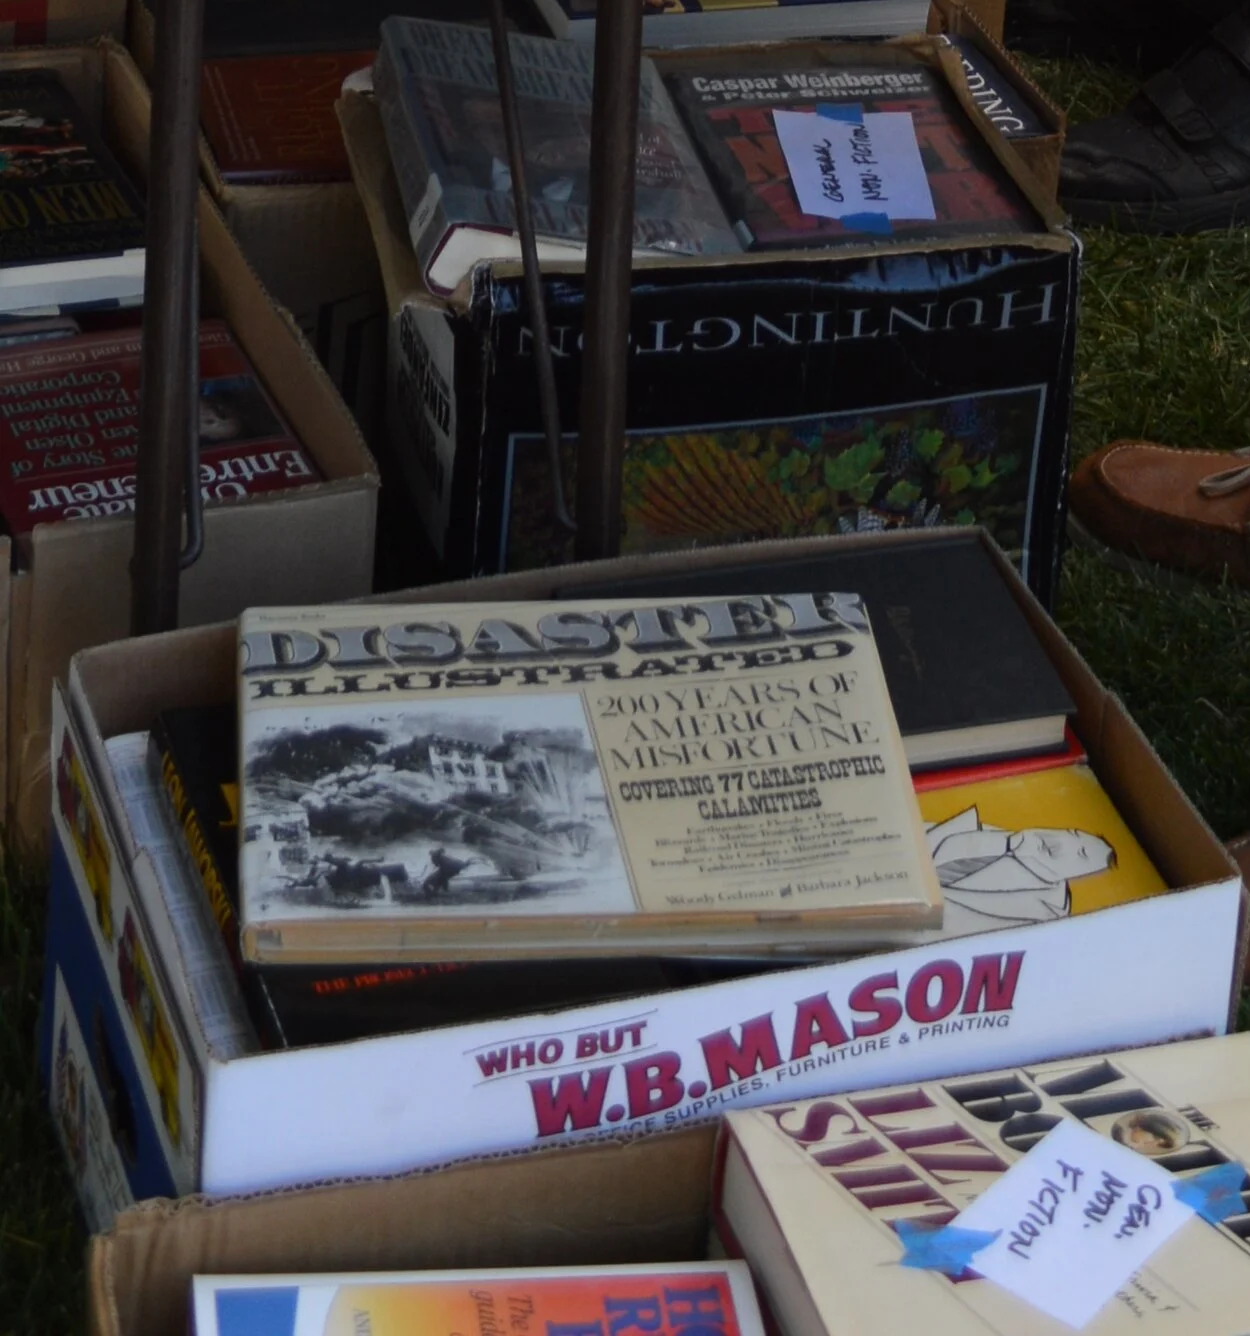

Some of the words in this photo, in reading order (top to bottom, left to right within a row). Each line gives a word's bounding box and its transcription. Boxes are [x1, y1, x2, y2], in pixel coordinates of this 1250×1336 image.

[693, 74, 778, 96] Caspar
[784, 68, 924, 95] Weinberger
[723, 90, 793, 104] Peter
[517, 279, 1063, 360] HUNTINGTN
[10, 410, 92, 441] Digital
[25, 430, 96, 453] Olsen
[42, 447, 107, 471] Story
[241, 592, 870, 675] DISASTER
[250, 639, 854, 699] ILLUSTRATED
[597, 693, 659, 718] 200
[664, 678, 802, 712] YEARS
[808, 671, 859, 696] OF
[623, 699, 846, 744] AMERICAN
[609, 720, 881, 773] MISFORTUNE
[619, 773, 714, 803] COVERING
[718, 772, 745, 793] 77
[749, 754, 886, 792] CATASTROPHIC
[698, 787, 822, 821] CALAMITIES
[666, 892, 716, 907] Woody
[796, 877, 852, 894] Barbara
[855, 869, 909, 888] Jackson
[475, 1034, 565, 1078] WHO
[575, 1020, 648, 1060] BUT
[663, 1076, 771, 1127] SUPPLIES,
[776, 1035, 892, 1083] FURNITURE
[898, 1031, 912, 1046] &
[917, 1015, 1010, 1042] PRINTING
[846, 1086, 1013, 1187] LIZ
[1007, 1158, 1085, 1262] FICTION
